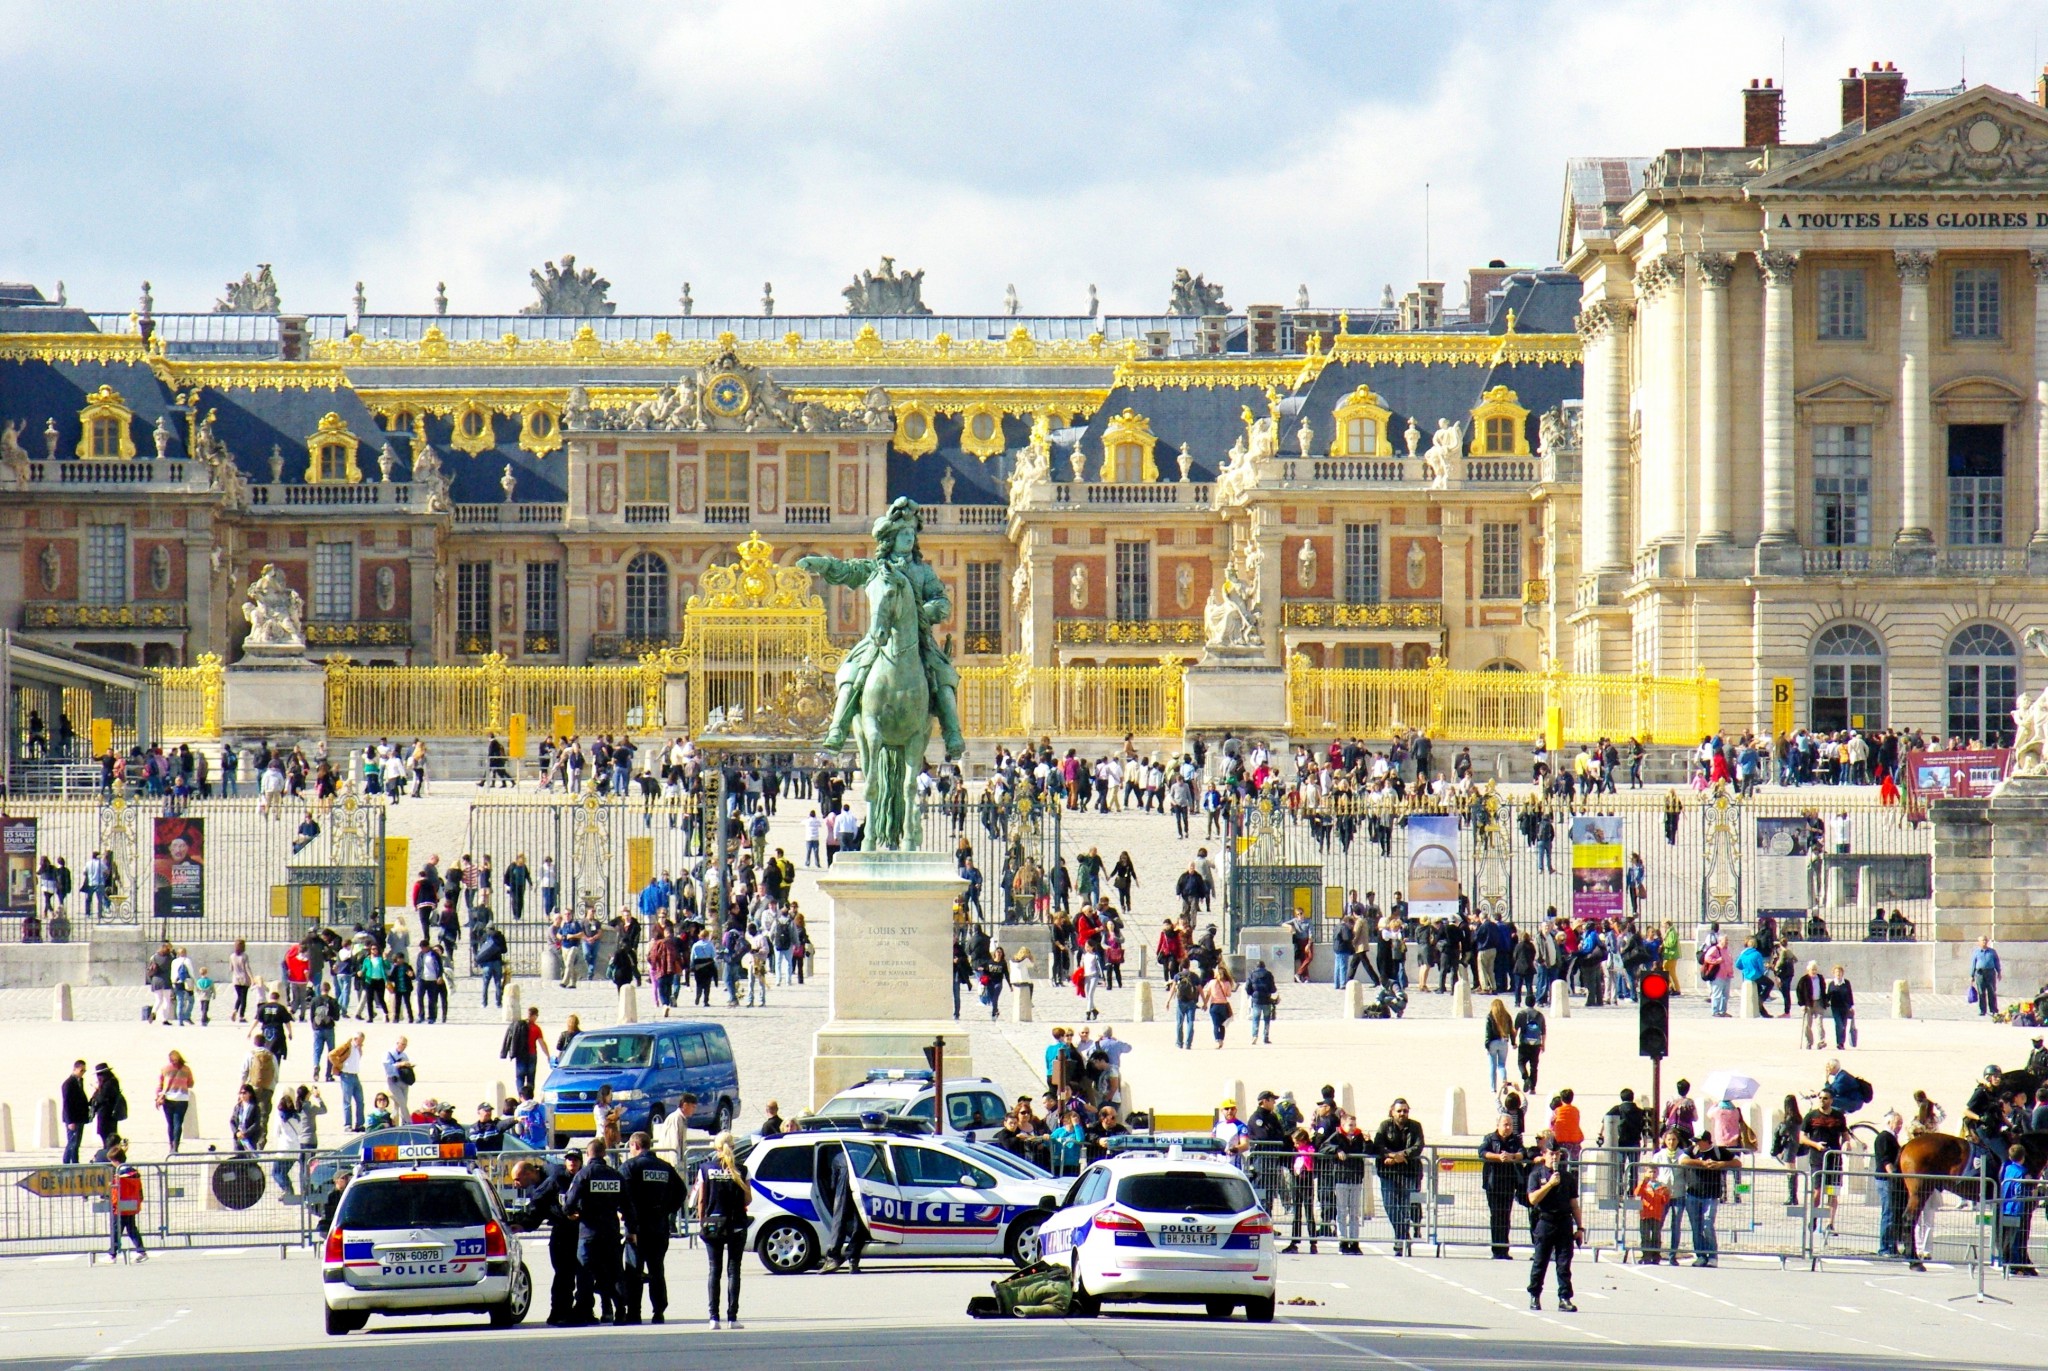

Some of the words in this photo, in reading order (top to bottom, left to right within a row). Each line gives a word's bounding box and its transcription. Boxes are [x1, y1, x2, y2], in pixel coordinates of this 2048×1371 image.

[1778, 213, 1792, 228] A
[1798, 213, 1881, 228] TOUTES
[1889, 213, 1929, 228] LES
[1937, 213, 2028, 228] GLOIRES
[1775, 684, 1789, 703] B
[868, 926, 896, 935] LOUIS
[900, 926, 919, 935] XIV
[1156, 1136, 1182, 1144] POLICE
[400, 1146, 438, 1157] POLICE
[644, 1171, 669, 1181] POLICE
[592, 1181, 619, 1191] POLICE
[872, 1197, 965, 1222] POLICE
[1160, 1225, 1204, 1233] POLICE
[468, 1244, 483, 1254] 17
[382, 1264, 448, 1276] POLICE
